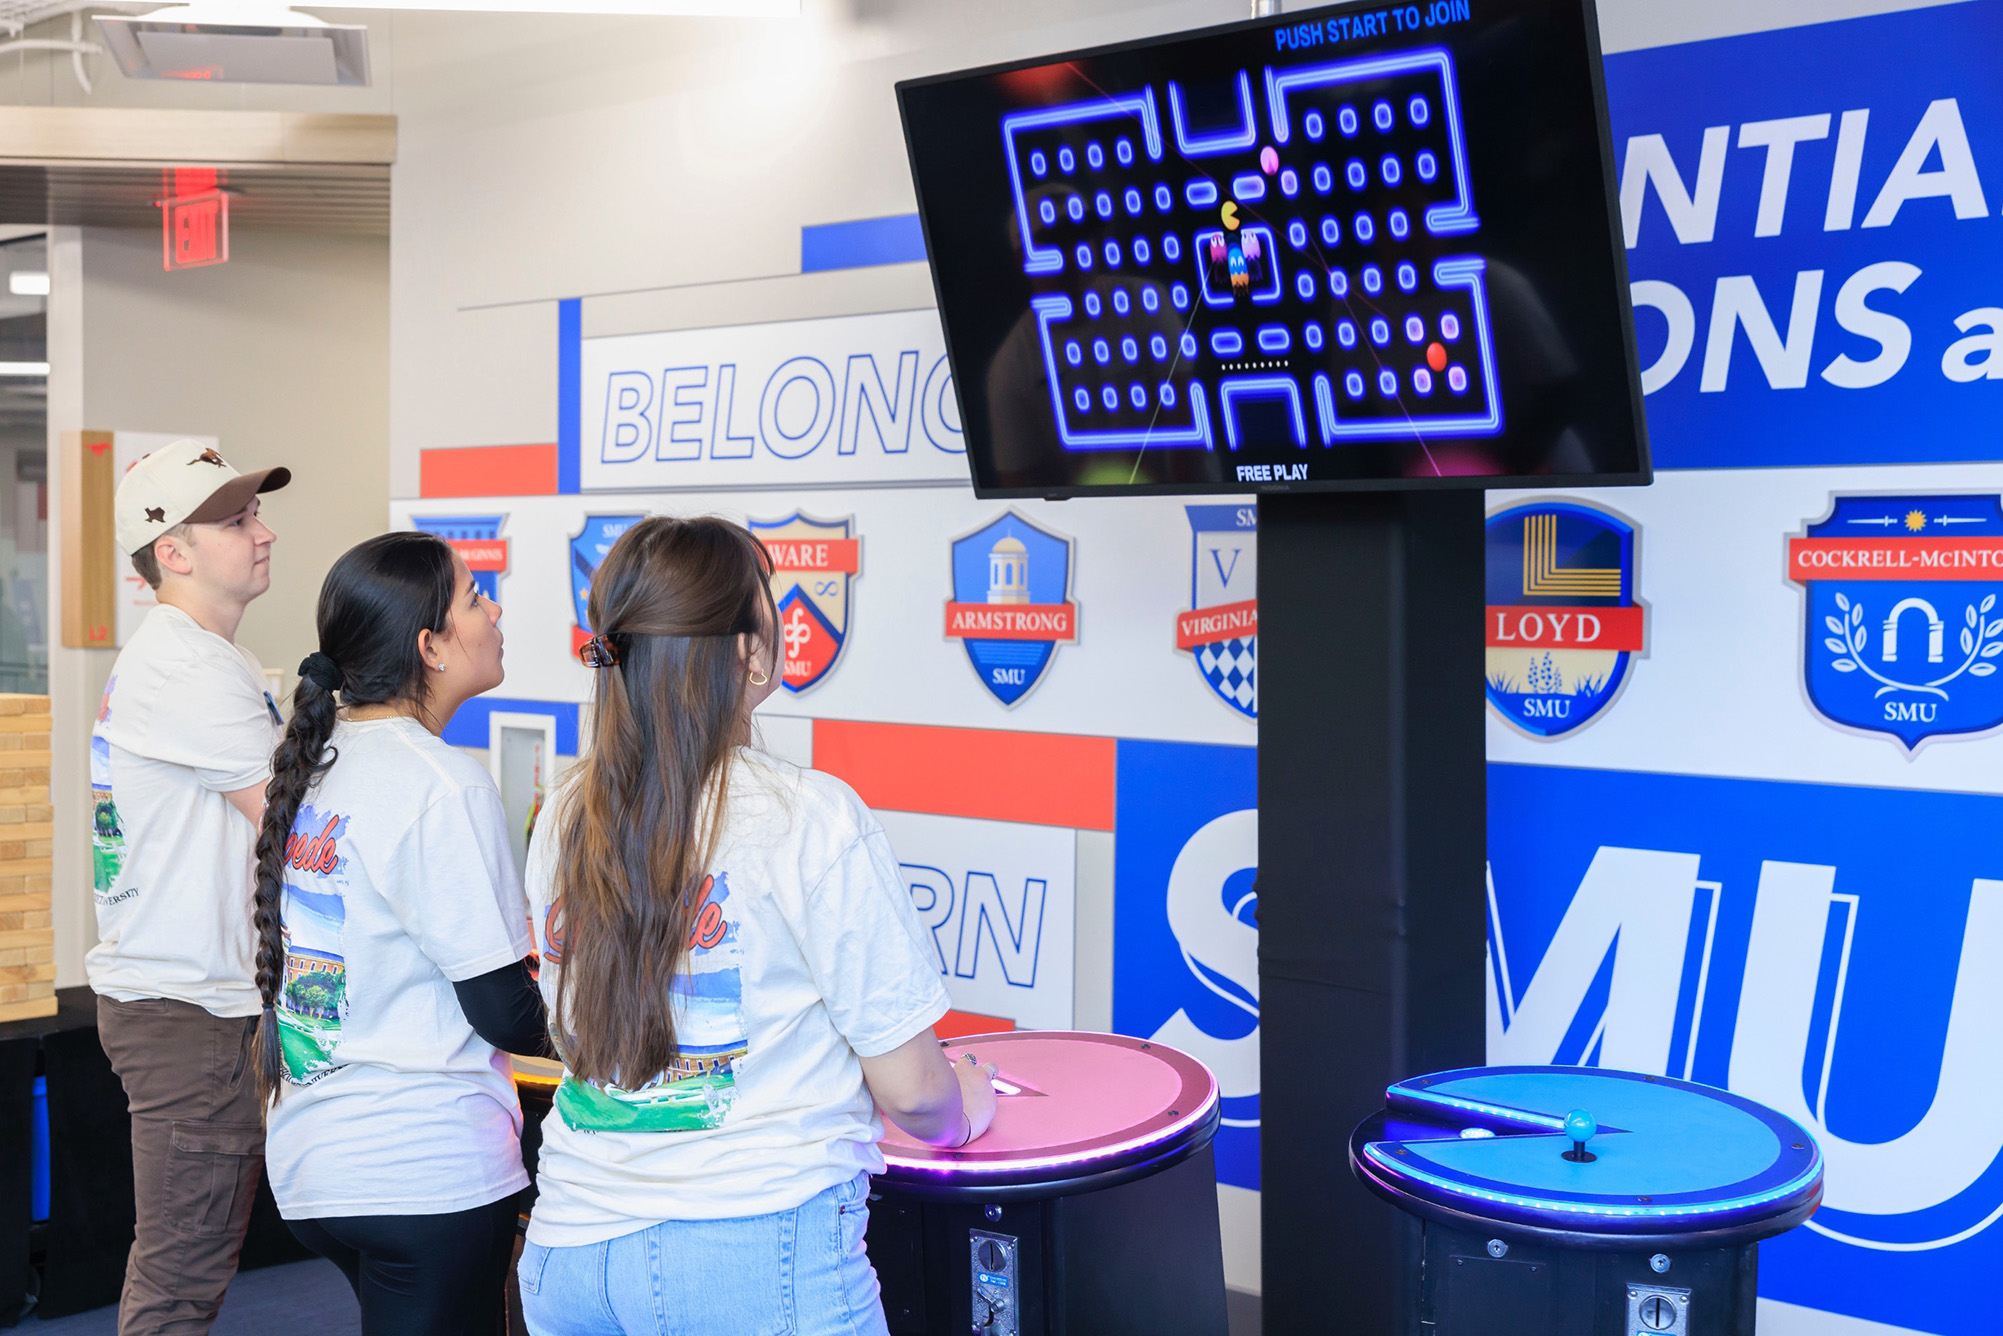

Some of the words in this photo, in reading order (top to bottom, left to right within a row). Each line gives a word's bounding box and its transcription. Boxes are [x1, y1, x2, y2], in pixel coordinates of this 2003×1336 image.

[1275, 21, 1324, 51] PUSH
[1327, 11, 1388, 44] START
[1396, 5, 1420, 33] TO
[1425, 0, 1471, 26] JOIN
[1236, 464, 1272, 482] FREE
[1273, 463, 1308, 481] PLAY
[952, 611, 1068, 633] ARMSTRONG
[1181, 608, 1257, 638] VIRGINIA
[1496, 612, 1602, 643] LOYD
[993, 667, 1026, 686] SMU
[1523, 697, 1571, 719] SMU
[1884, 701, 1938, 723] SMU
